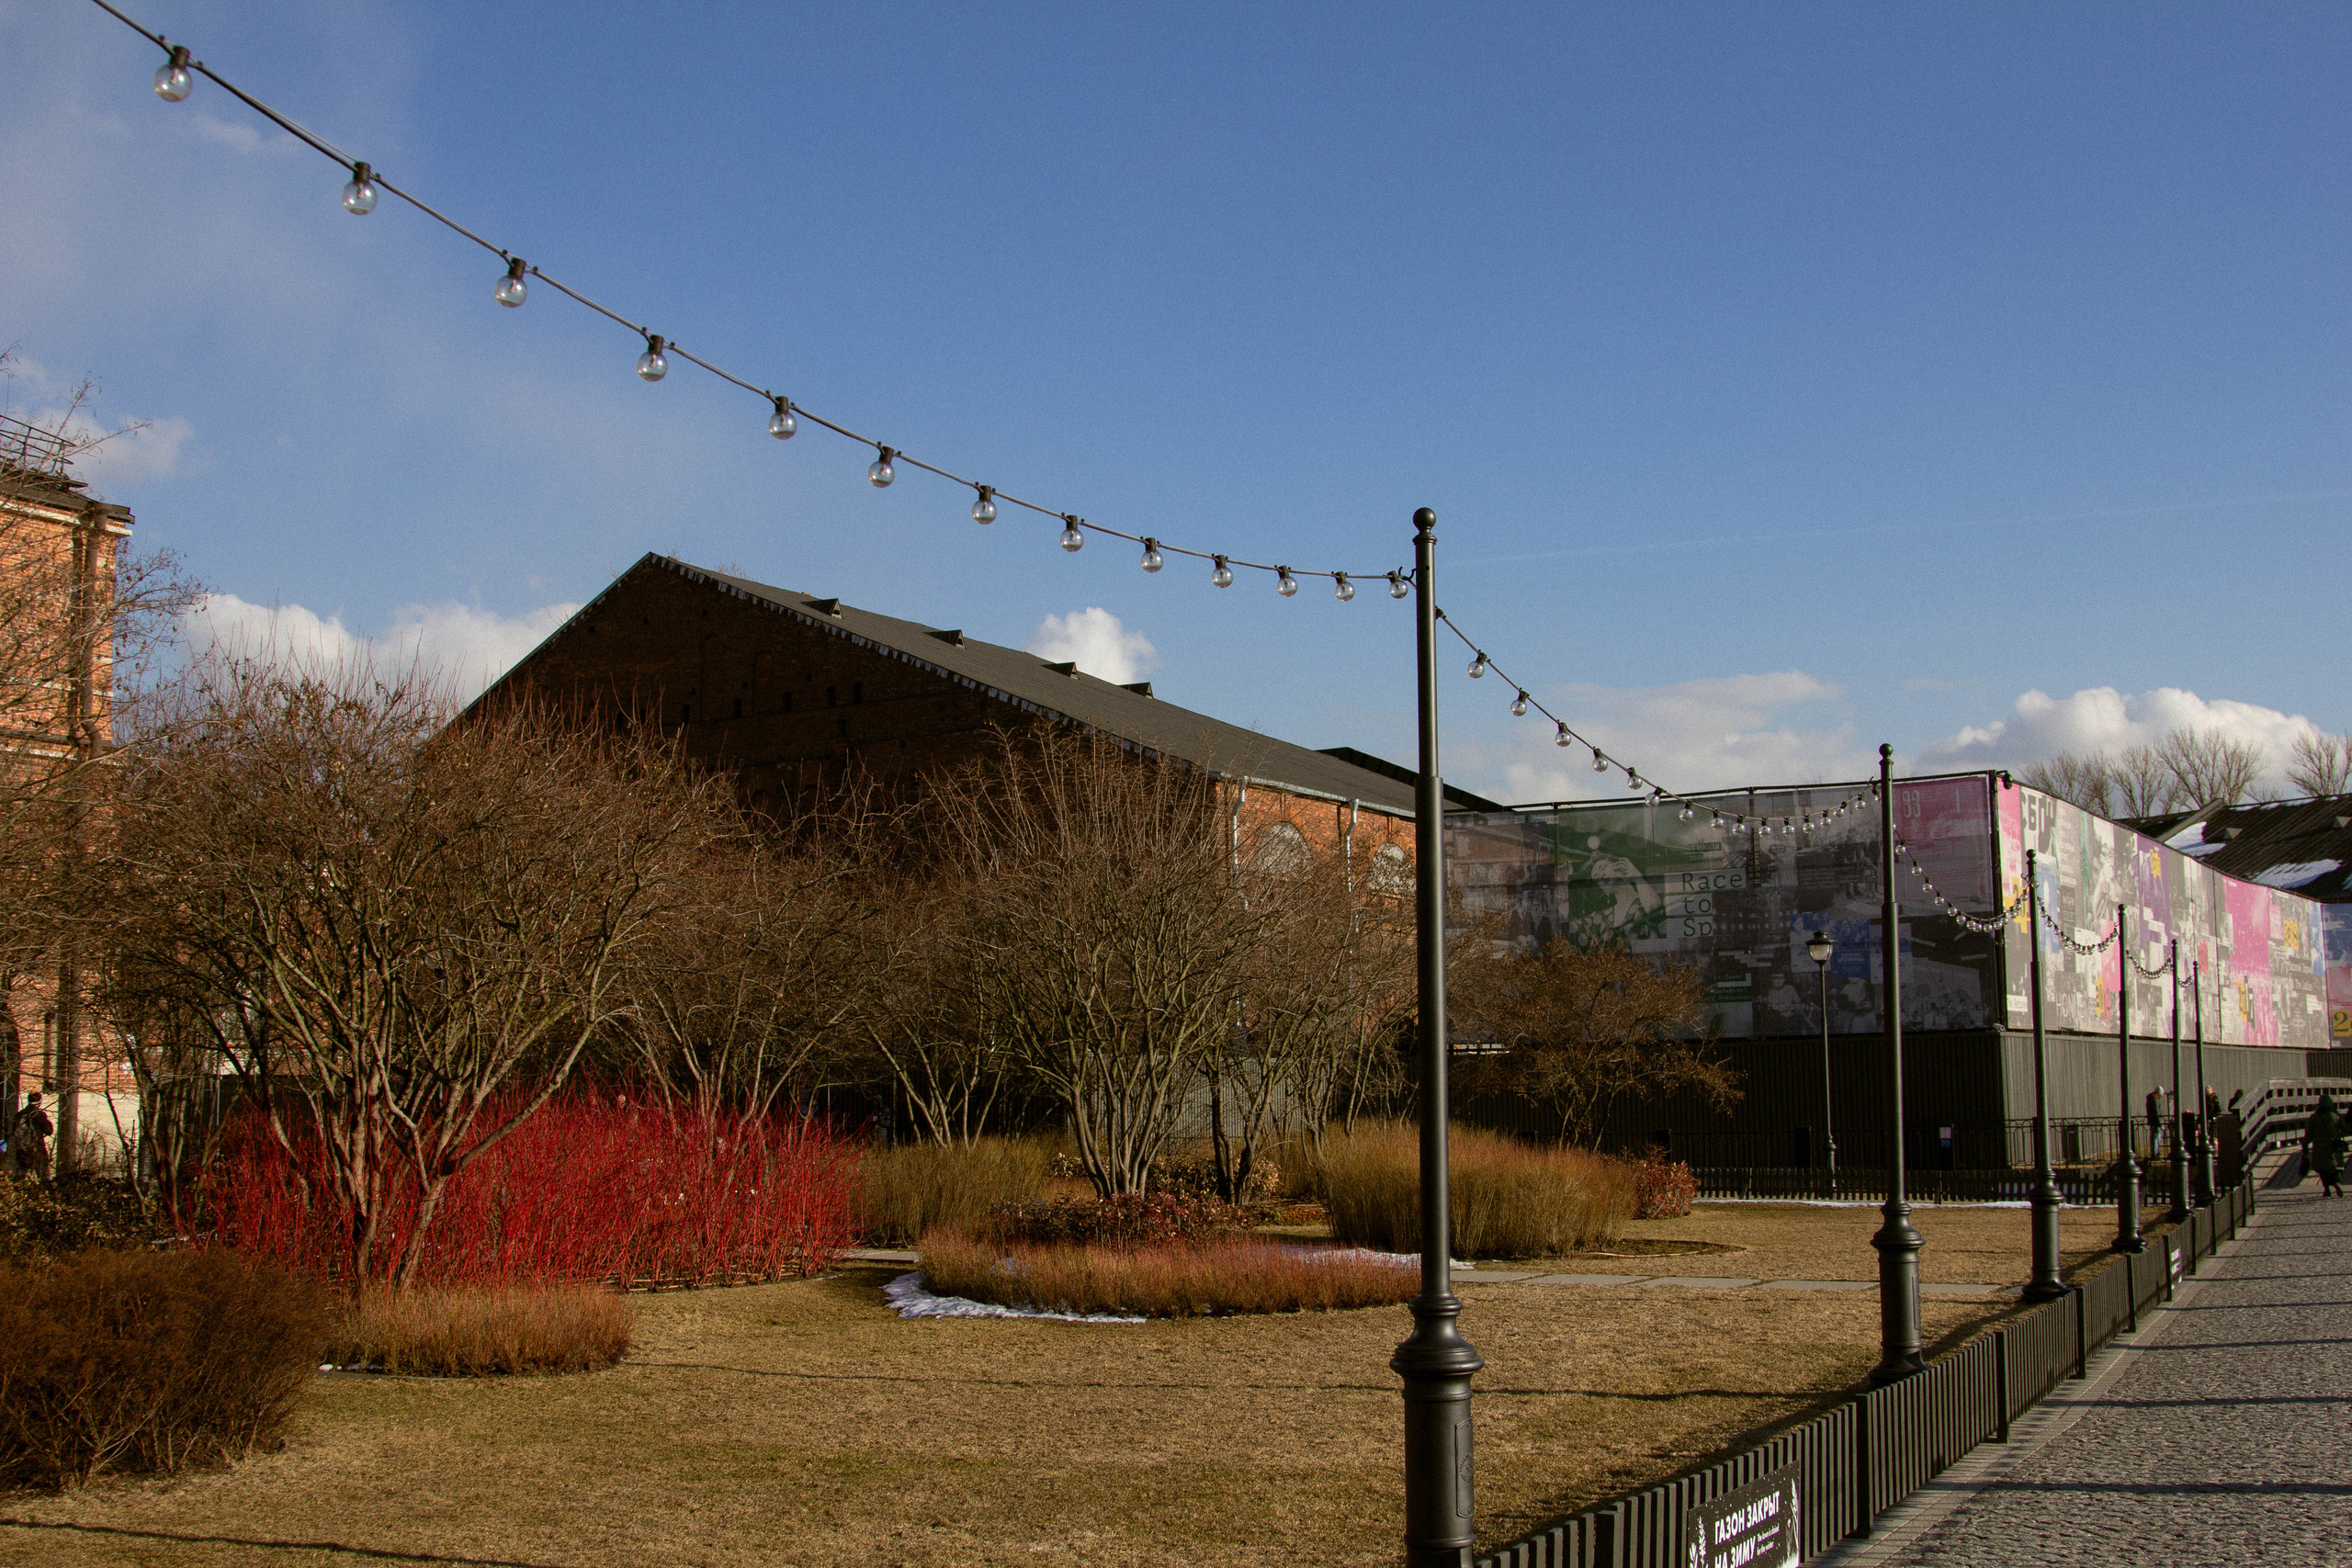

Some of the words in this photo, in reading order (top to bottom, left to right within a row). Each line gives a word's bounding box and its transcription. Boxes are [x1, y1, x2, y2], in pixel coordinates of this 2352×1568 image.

[1681, 872, 1743, 891] Race
[1681, 897, 1712, 914] to
[1683, 917, 1713, 937] Sp
[1714, 1508, 1746, 1545] ГАЗОН
[1747, 1491, 1780, 1529] ЗАКРЫТ
[1714, 1551, 1728, 1568] НА
[1730, 1536, 1756, 1568] ЗИМУ
